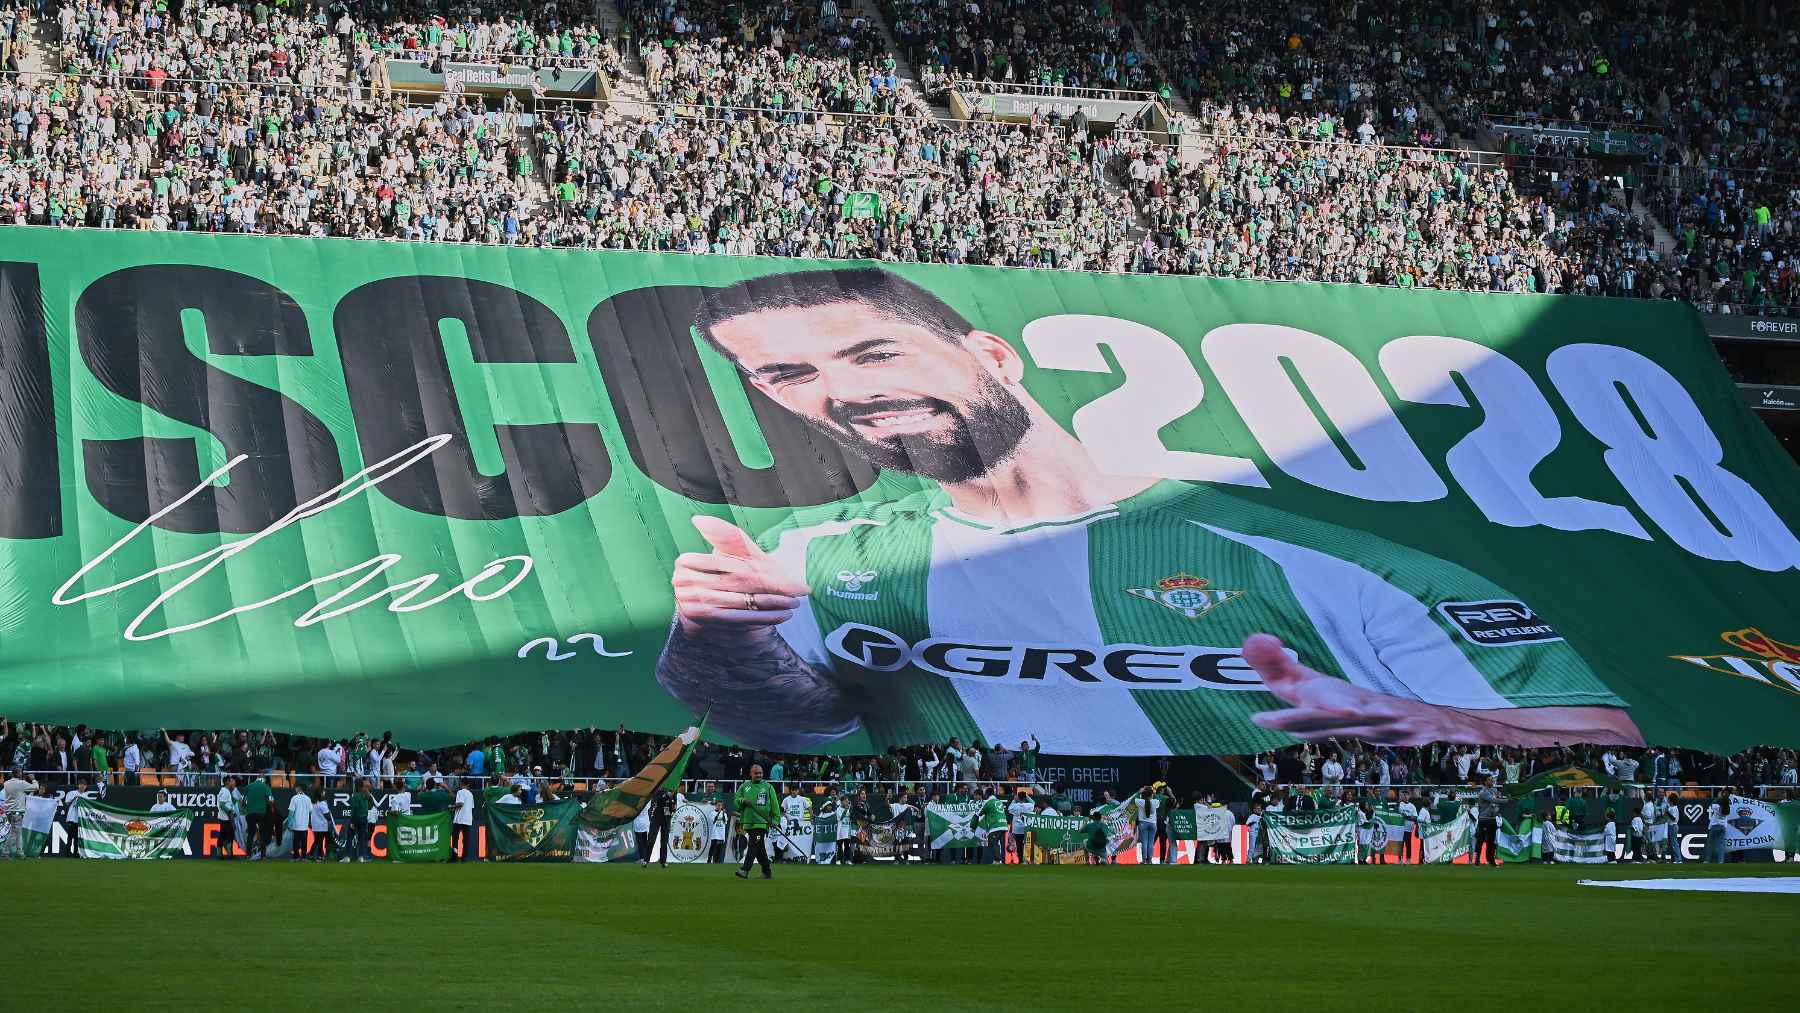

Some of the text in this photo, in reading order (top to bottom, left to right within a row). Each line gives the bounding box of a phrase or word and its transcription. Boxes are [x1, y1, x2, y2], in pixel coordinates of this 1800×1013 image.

[1751, 320, 1798, 333] FOREVER
[1021, 314, 1800, 571] 2028
[826, 584, 879, 600] hummel
[1072, 768, 1120, 783] GREEN
[167, 793, 219, 807] ruzca
[1300, 832, 1354, 847] PEÑAS
[1724, 833, 1776, 848] STEPONA
